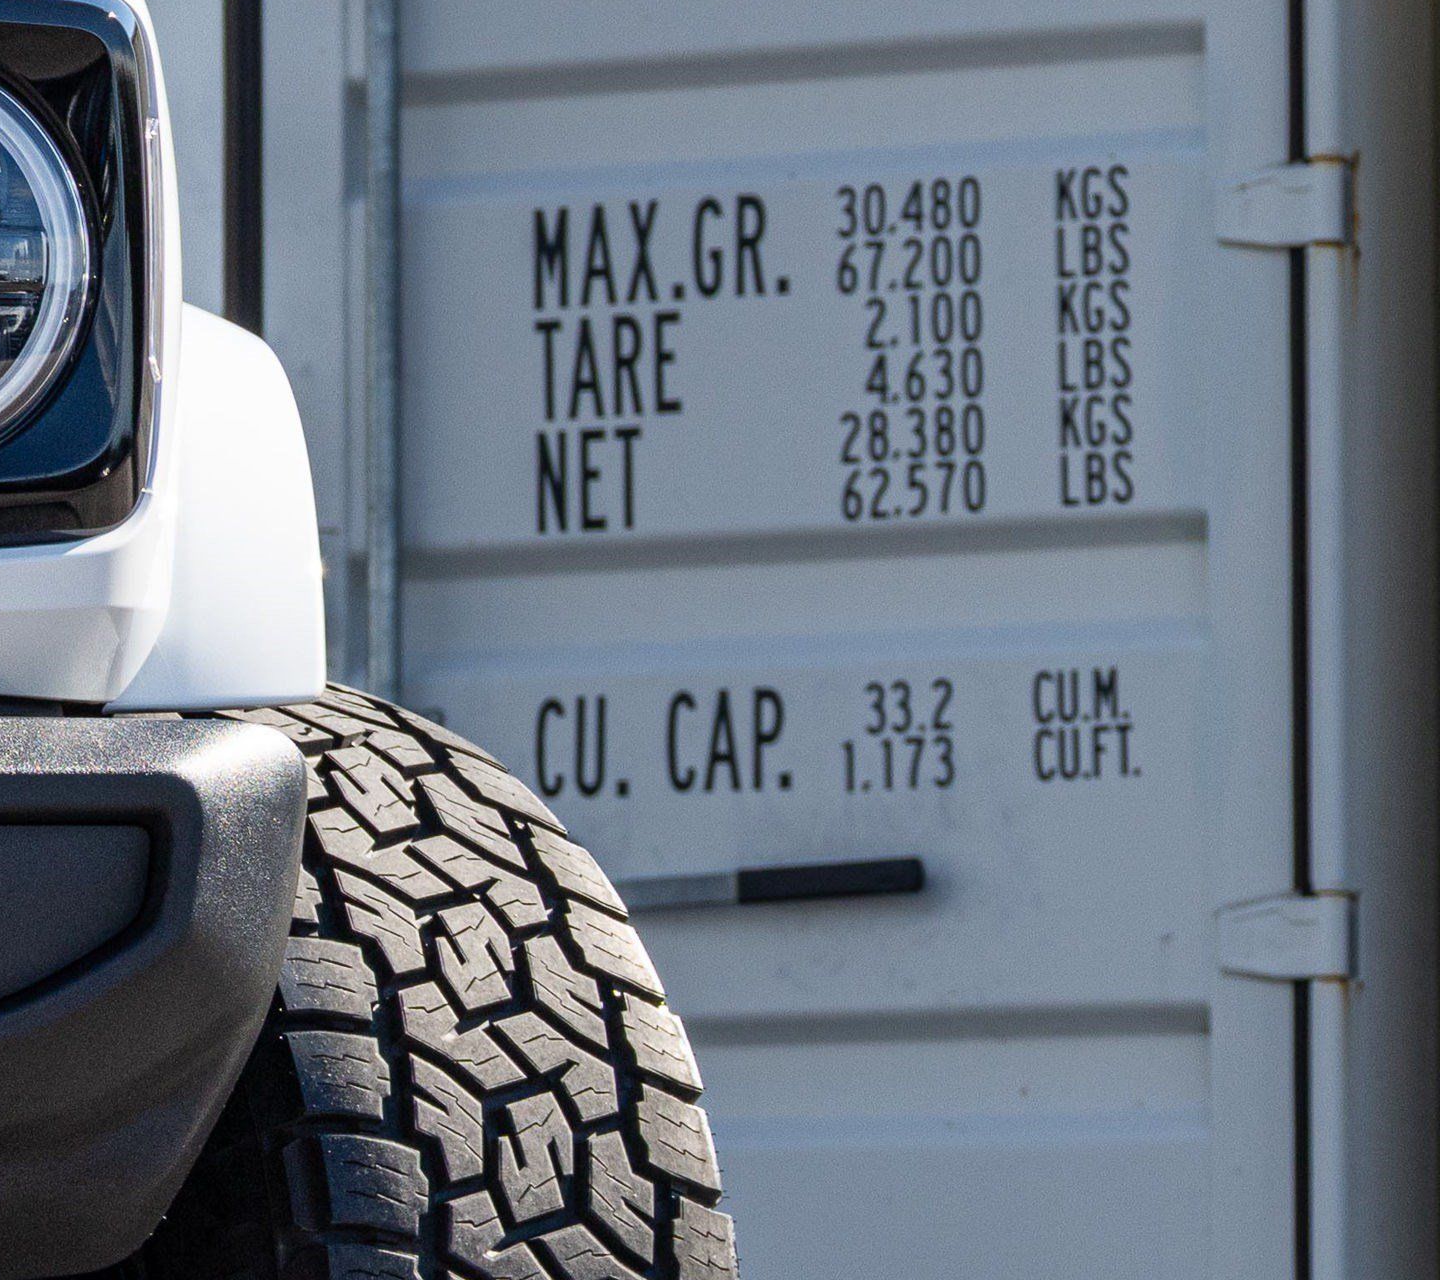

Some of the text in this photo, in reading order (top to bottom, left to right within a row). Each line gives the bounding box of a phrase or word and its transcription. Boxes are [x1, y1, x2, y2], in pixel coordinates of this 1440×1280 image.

[533, 165, 1131, 311] MAX.GR. 30.480 KGS
[836, 222, 1132, 296] 67.200 LBS
[535, 280, 1132, 421] TARE 2.100 KGS
[865, 337, 1133, 405] 4.630 LBS
[536, 395, 1133, 534] NET 28.380 KGS
[841, 451, 1135, 522] 62.570 LBS
[536, 666, 1130, 798] CU. CAP. 33.2 CU.M.
[844, 723, 1142, 793] 1.173 CU.FT.
